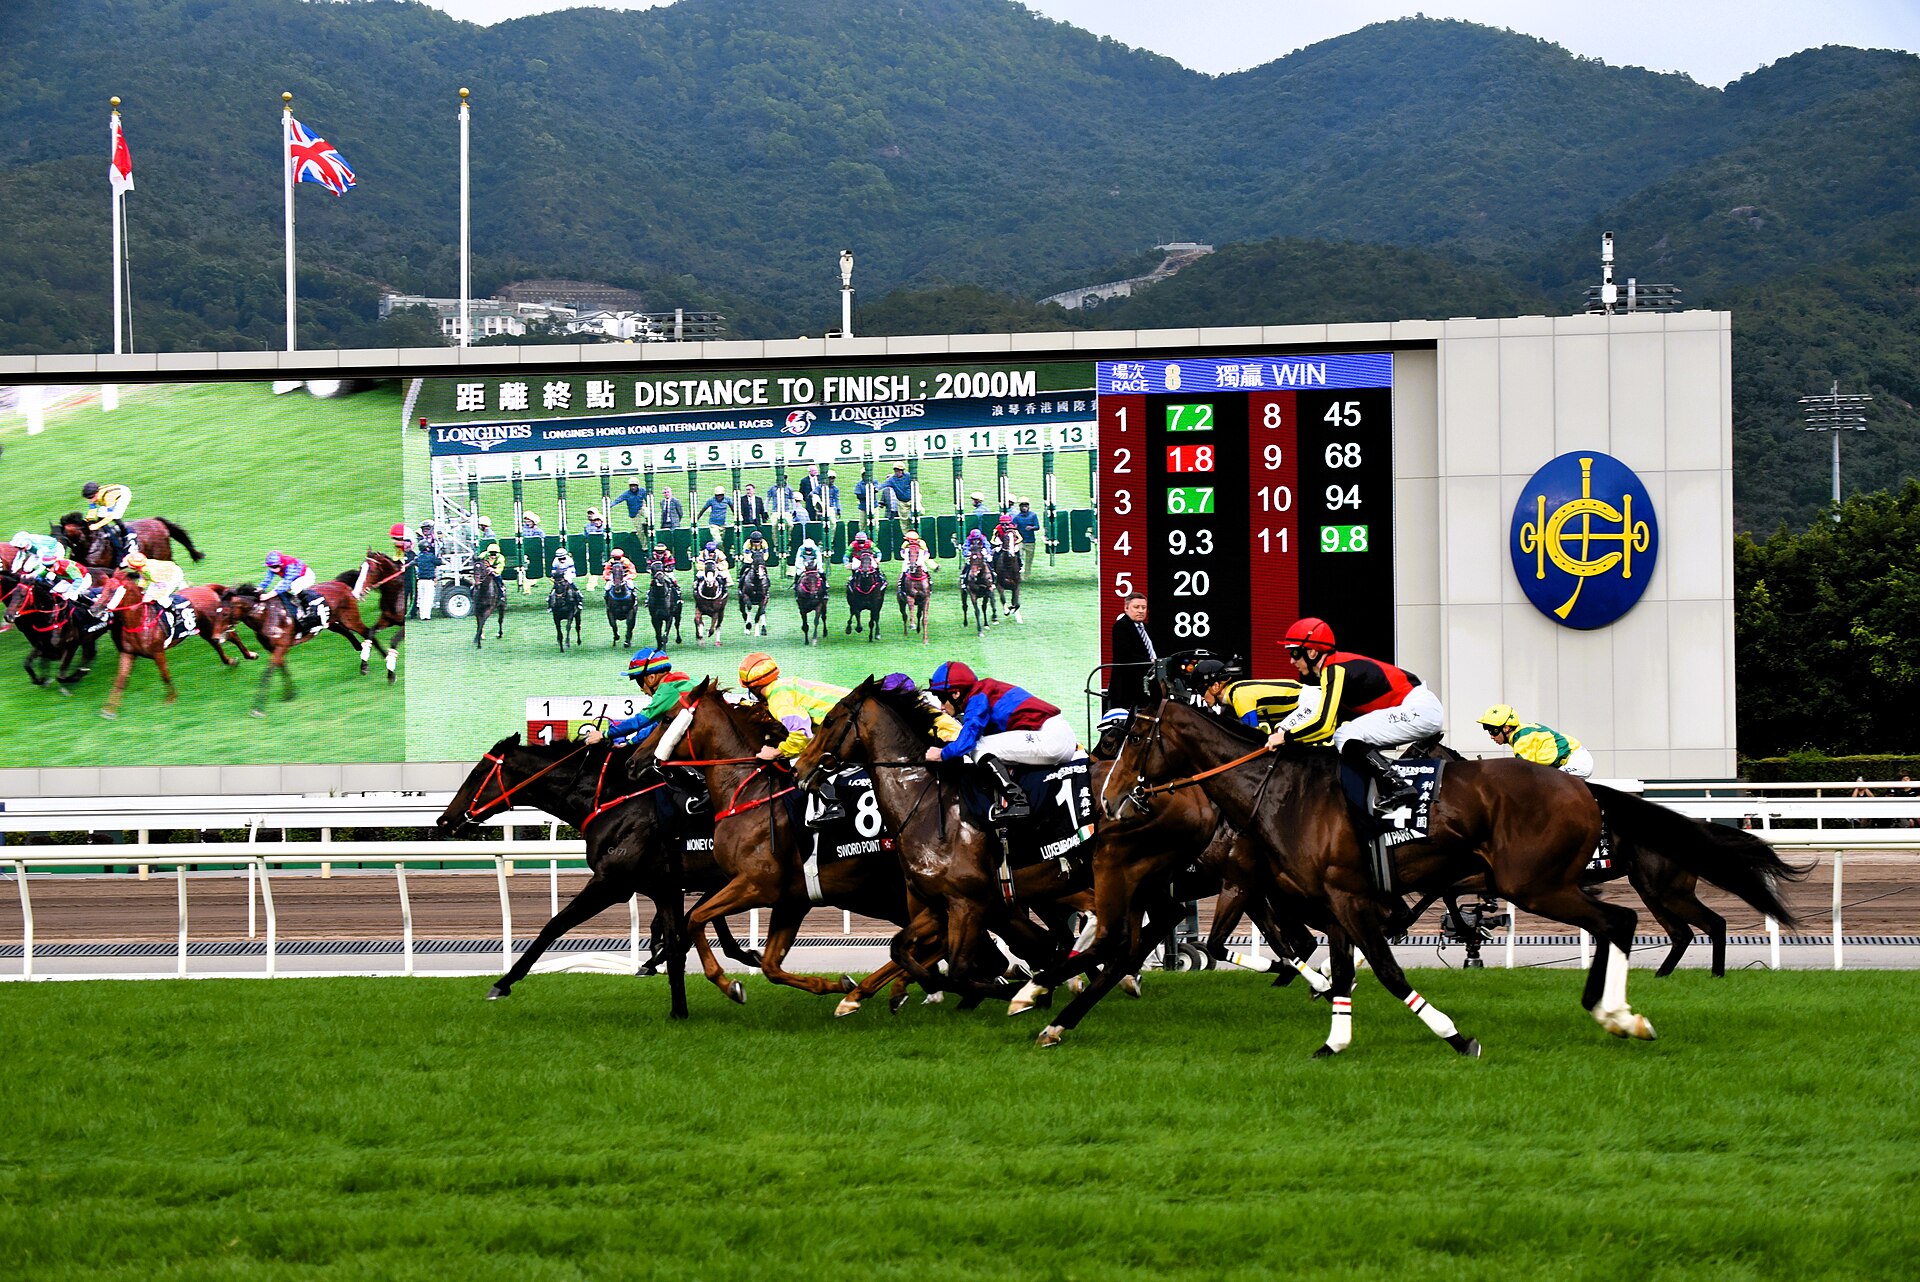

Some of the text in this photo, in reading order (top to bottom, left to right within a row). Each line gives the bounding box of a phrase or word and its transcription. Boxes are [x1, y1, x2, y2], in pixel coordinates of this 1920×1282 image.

[1112, 364, 1145, 379] 場次
[1216, 364, 1326, 387] 獨贏 WIN
[456, 380, 616, 411] 距離終點
[635, 379, 768, 407] DISTANCE
[778, 378, 814, 402] TO
[824, 376, 910, 401] FINISH
[936, 371, 1036, 397] 2000M
[1112, 380, 1149, 391] RACE
[830, 404, 925, 422] LONGINES
[1115, 402, 1361, 432] 1 7.2 8 45
[436, 425, 532, 443] LONGINES
[543, 419, 774, 440] LONGINES HONG KONG INTERNATIONAL RACES
[534, 427, 1083, 471] 1 2 3 4 5 6 7 8 9 10 11 12 13
[1113, 443, 1362, 473] 2 1.8 9 68
[1113, 484, 1362, 515] 3 6.7 10 94
[1113, 526, 1368, 556] 4 9.3 11 9.8
[1114, 570, 1210, 598] 5 20
[1173, 611, 1210, 637] 88
[543, 699, 634, 717] 1 2 3
[854, 789, 883, 838] 8
[1055, 778, 1079, 831] 1
[836, 839, 881, 858] SWORD POINT
